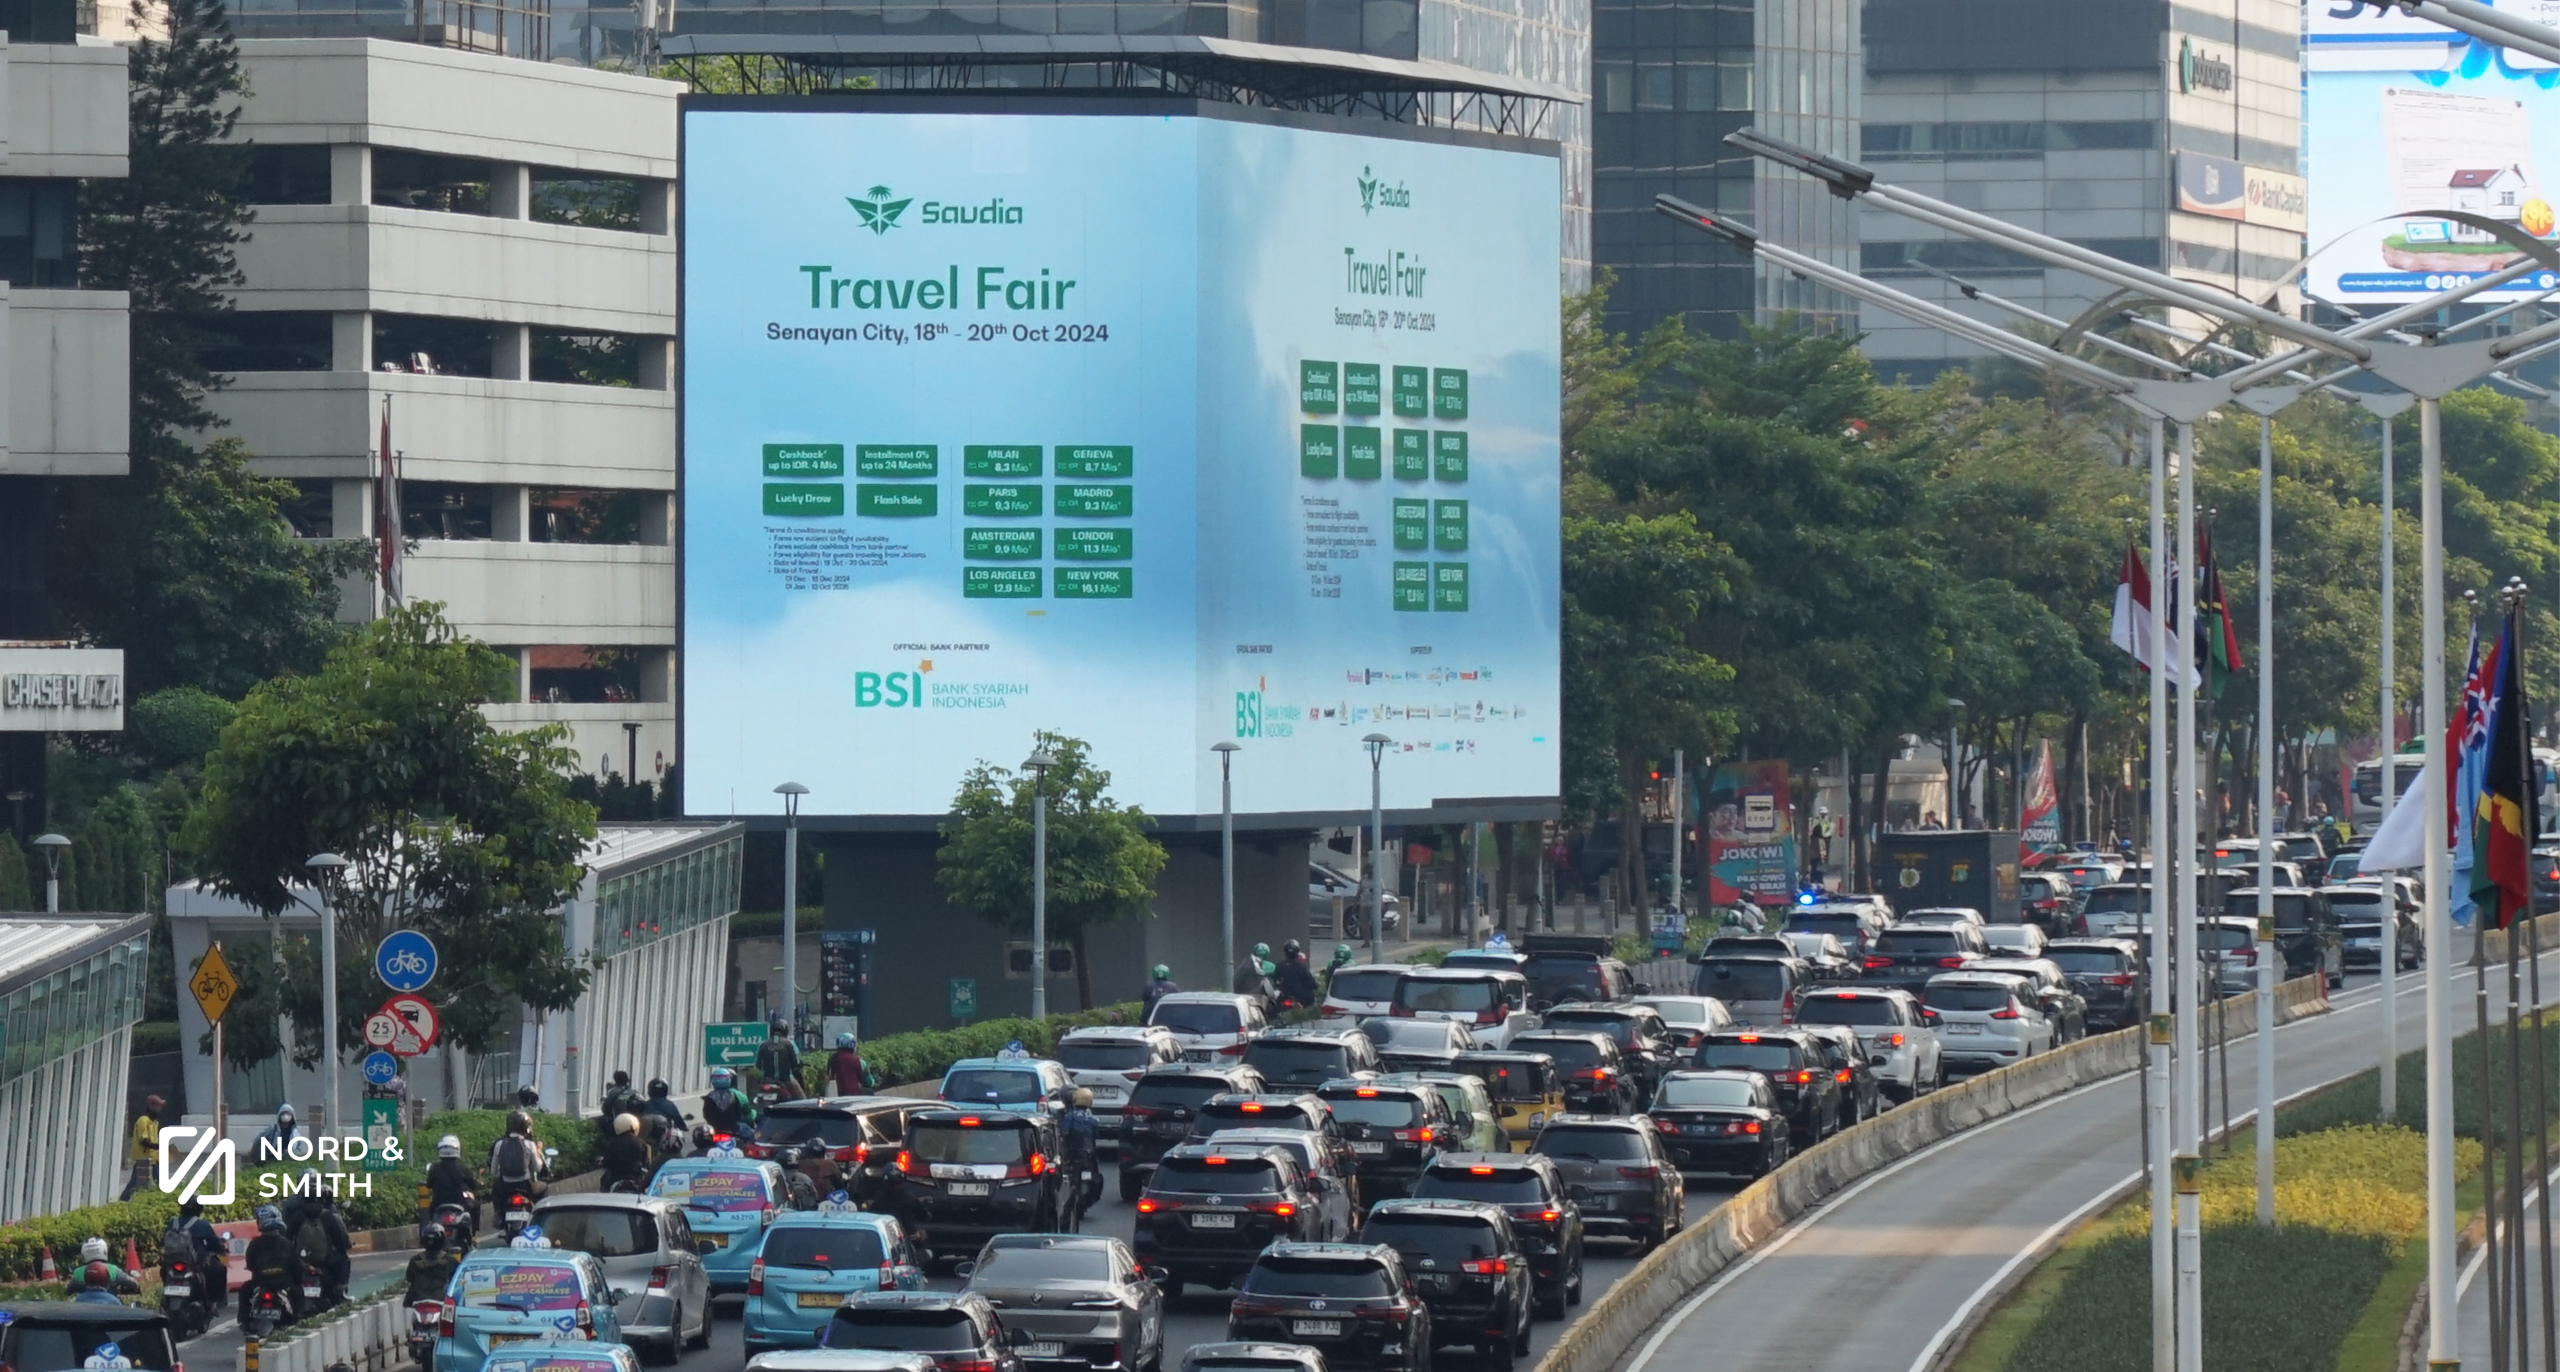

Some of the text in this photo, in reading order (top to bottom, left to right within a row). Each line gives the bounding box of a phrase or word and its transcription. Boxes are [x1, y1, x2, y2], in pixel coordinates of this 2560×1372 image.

[922, 198, 1023, 225] Saudia
[1344, 247, 1426, 298] Travel Fair
[800, 265, 1076, 310] Travel Fair
[766, 322, 858, 345] Senayan
[863, 323, 909, 346] City,
[914, 323, 949, 342] 18th
[967, 324, 1007, 342] 20th
[1012, 324, 1049, 343] Oct
[1054, 325, 1109, 343] 2024
[865, 450, 913, 459] Installment
[987, 450, 1019, 459] MILAN
[1073, 450, 1113, 459] GENEVA
[898, 462, 932, 470] Months
[988, 488, 1018, 497] PARIS
[1073, 488, 1113, 497] MADRID
[775, 493, 831, 505] Lucky Draw
[874, 496, 922, 504] Flash Sale
[970, 531, 1035, 541] AMSTERDAM
[1072, 531, 1113, 541] LONDON
[970, 571, 1036, 580] LOS ANGELES
[1067, 571, 1119, 580] NEW YORK
[4, 673, 122, 707] CHASE PLAZA
[855, 671, 922, 708] BSI
[932, 683, 1028, 695] BANK SYARIAH
[932, 696, 1006, 708] INDONESIA
[1236, 691, 1262, 737] BSI
[1719, 846, 1784, 860] JOKOWI
[372, 1021, 390, 1034] 25
[731, 1026, 742, 1035] IN
[694, 1178, 734, 1187] EZPAY
[501, 1274, 545, 1283] EZPAY
